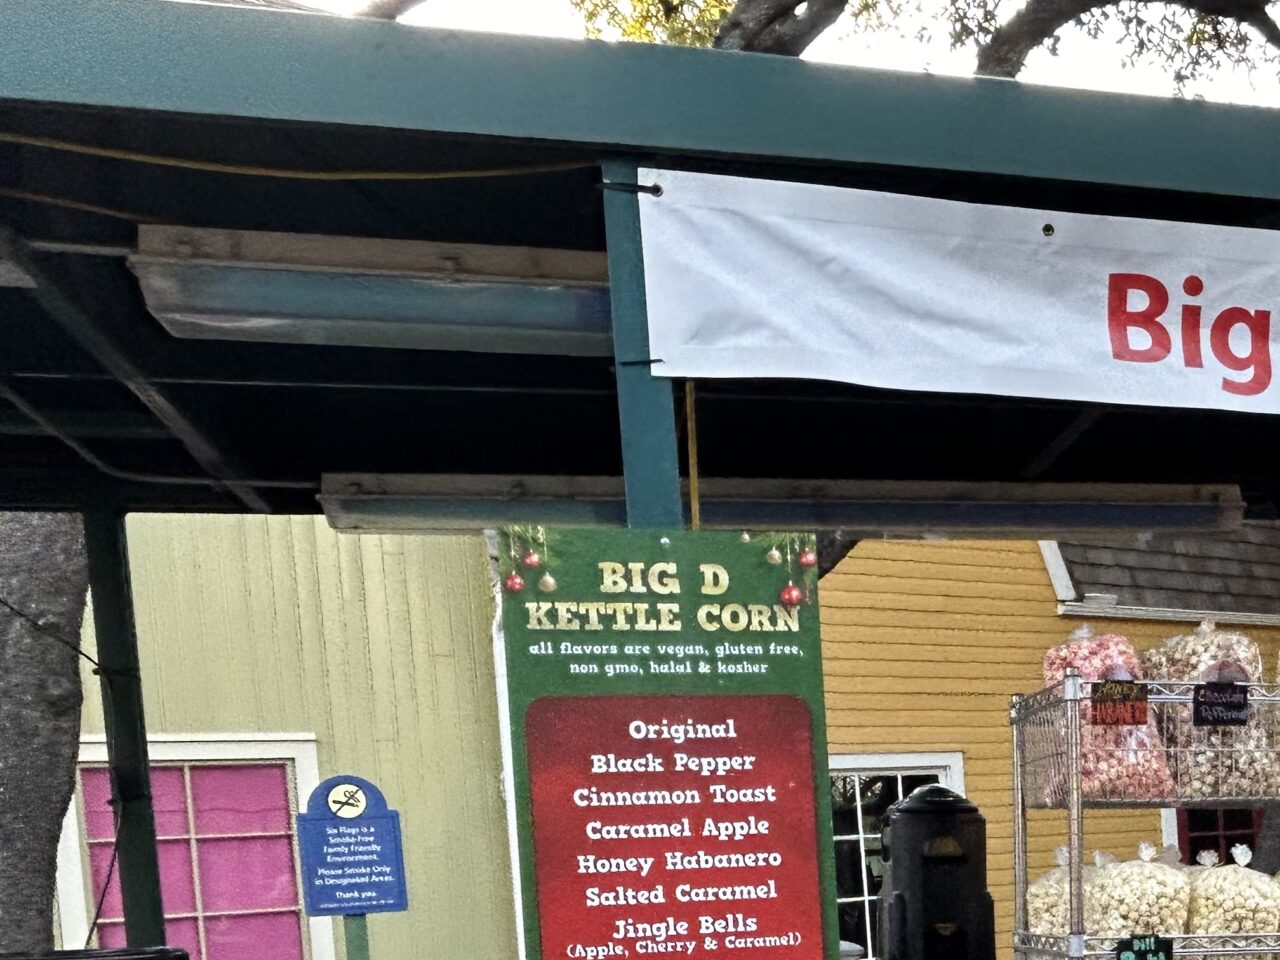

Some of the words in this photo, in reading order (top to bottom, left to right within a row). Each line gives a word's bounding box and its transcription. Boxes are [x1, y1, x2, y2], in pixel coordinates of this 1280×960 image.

[1107, 273, 1273, 395] Big
[598, 562, 681, 594] BIG
[699, 563, 729, 595] D
[525, 602, 681, 631] KETTLE
[697, 603, 800, 632] CORN
[529, 642, 553, 654] all
[560, 642, 618, 654] flavors
[625, 644, 649, 654] are
[658, 644, 709, 657] vegan,
[715, 643, 763, 657] gluten
[769, 642, 804, 656] free,
[570, 664, 598, 673] non
[605, 664, 644, 676] gmo,
[650, 661, 692, 673] halal
[699, 662, 711, 672] &
[718, 661, 768, 672] kosher
[629, 719, 737, 743] Original
[591, 754, 663, 773] Black
[674, 754, 755, 776] Pepper
[573, 787, 701, 807] Cinnamon
[710, 784, 776, 803] Toast
[586, 818, 691, 840] Caramel
[702, 817, 769, 838] Apple
[578, 855, 654, 877] Honey
[666, 851, 782, 870] Habanero
[586, 886, 664, 907] Salted
[676, 881, 777, 901] Caramel
[613, 919, 688, 942] Jingle
[699, 914, 758, 934] Bells
[566, 941, 629, 959] (Apple,
[636, 939, 696, 954] Cherry
[704, 938, 718, 949] &
[725, 932, 801, 949] Caramel)
